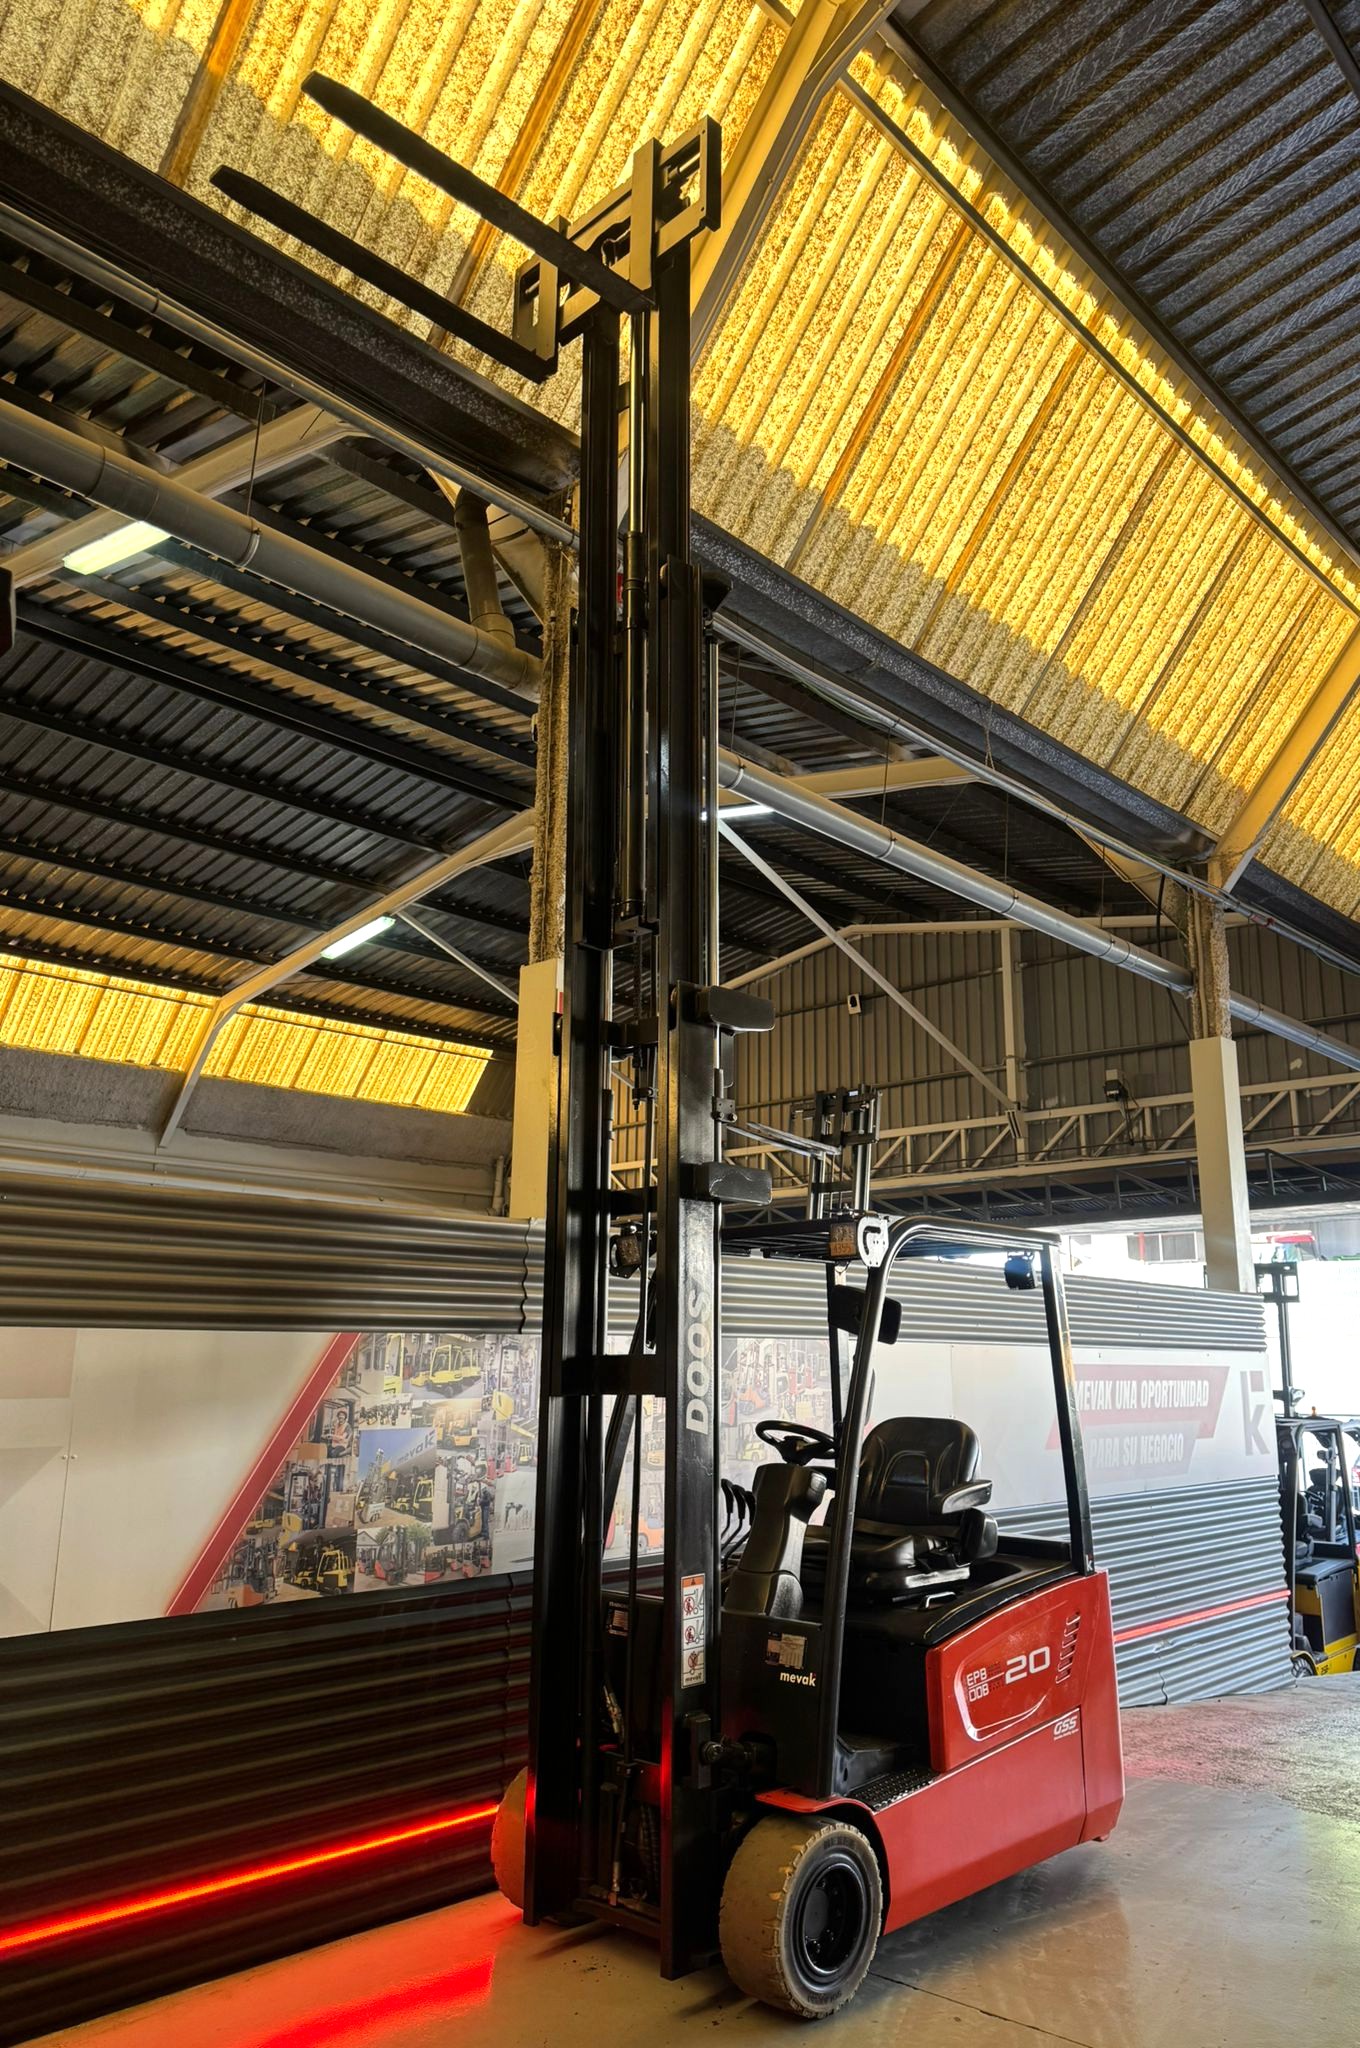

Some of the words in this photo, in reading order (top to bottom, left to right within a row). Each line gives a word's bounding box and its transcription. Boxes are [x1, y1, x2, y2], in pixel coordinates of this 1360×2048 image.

[1075, 1380, 1112, 1411] MEVAK
[1115, 1380, 1137, 1409] UNA
[1140, 1379, 1210, 1409] OPORTUNIDAD
[1090, 1437, 1120, 1469] PARA
[1123, 1435, 1138, 1467] SU
[1140, 1433, 1184, 1465] NEGOCIO
[779, 1671, 817, 1687] mevak
[966, 1667, 987, 1686] EPB
[1005, 1646, 1050, 1684] 20
